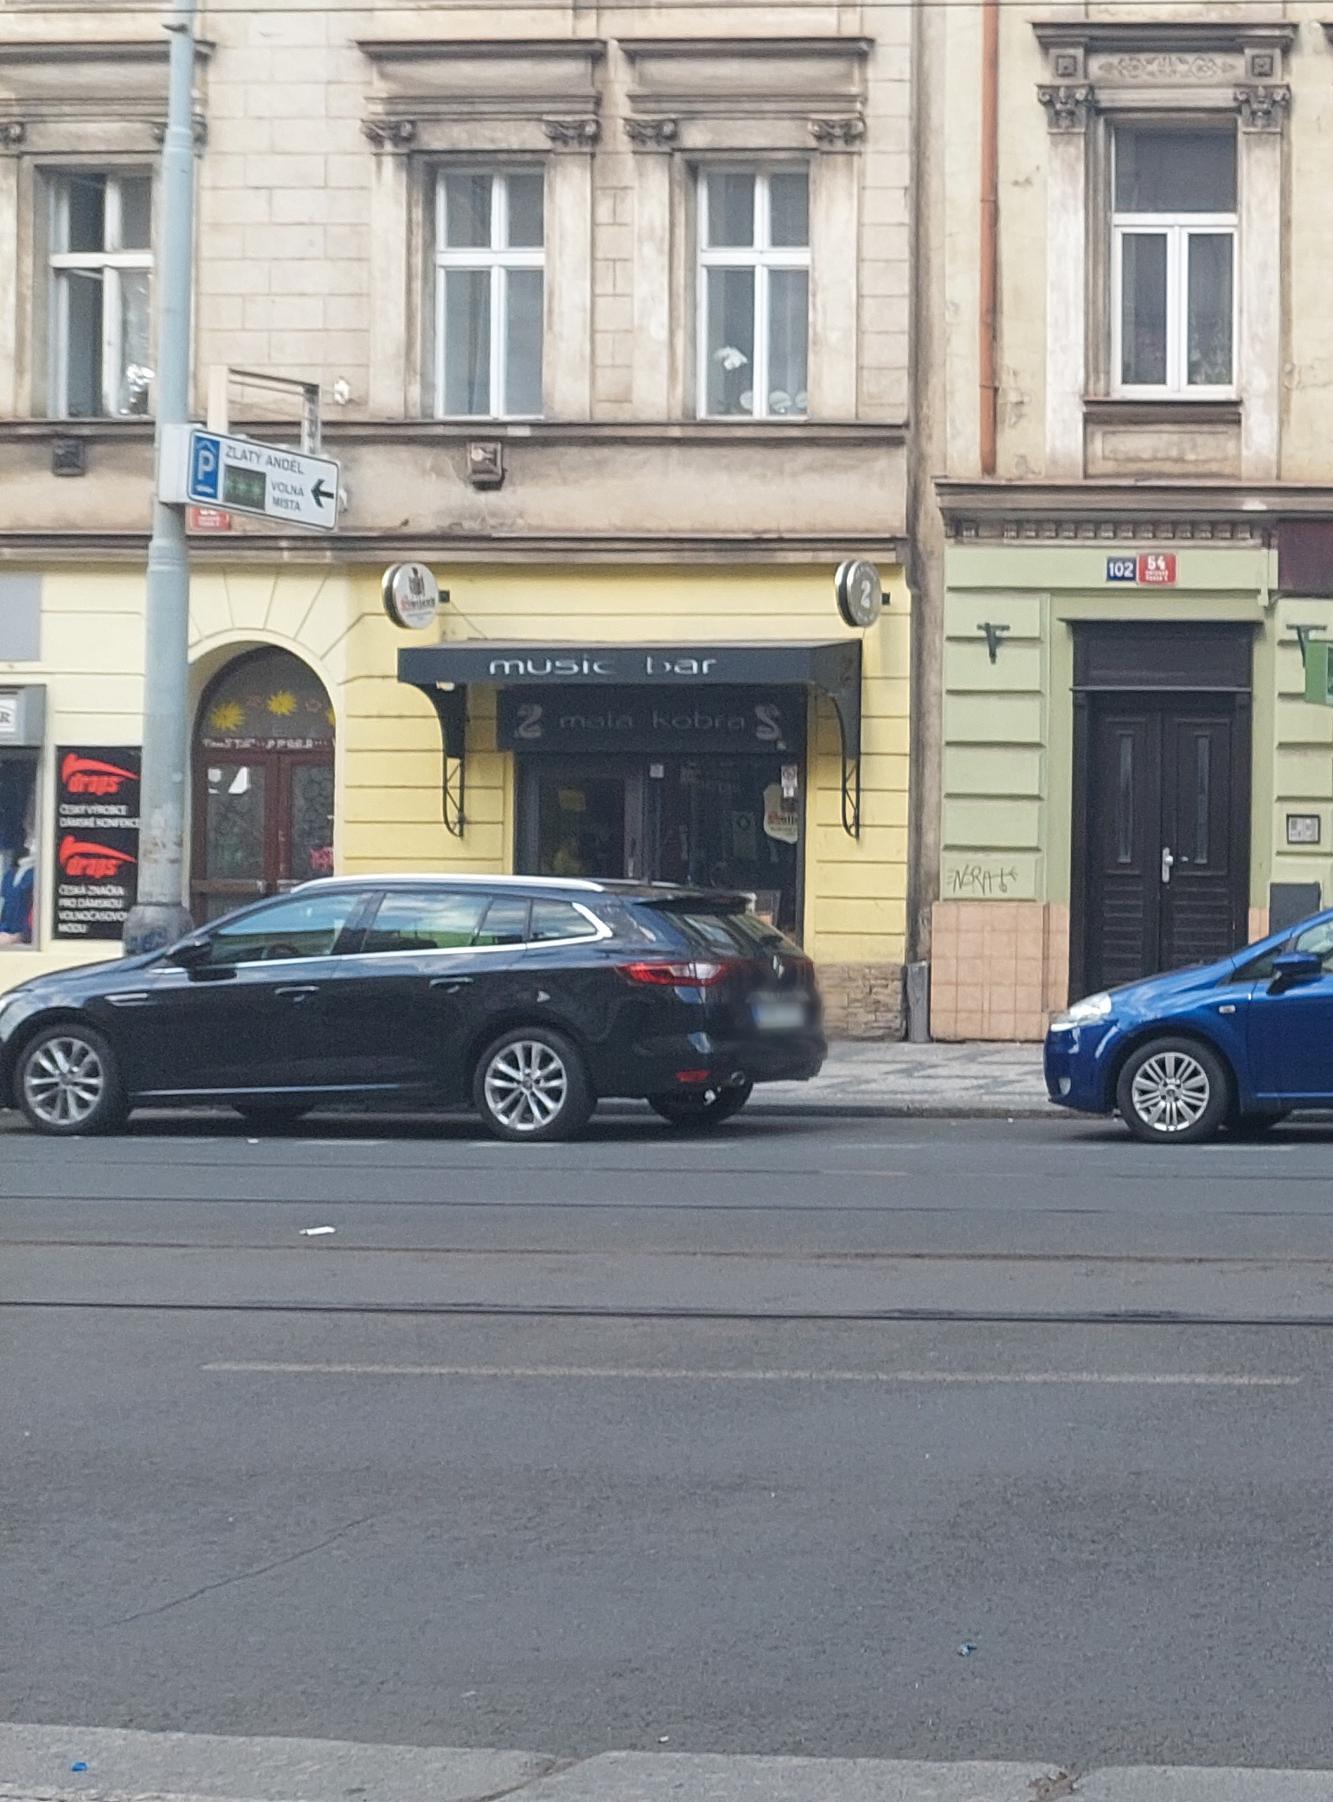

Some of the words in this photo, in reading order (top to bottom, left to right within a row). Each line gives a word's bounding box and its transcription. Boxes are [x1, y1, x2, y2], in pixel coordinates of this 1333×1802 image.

[1109, 561, 1134, 578] 102
[489, 654, 616, 676] music
[646, 656, 718, 676] bar
[653, 709, 745, 730] kobra
